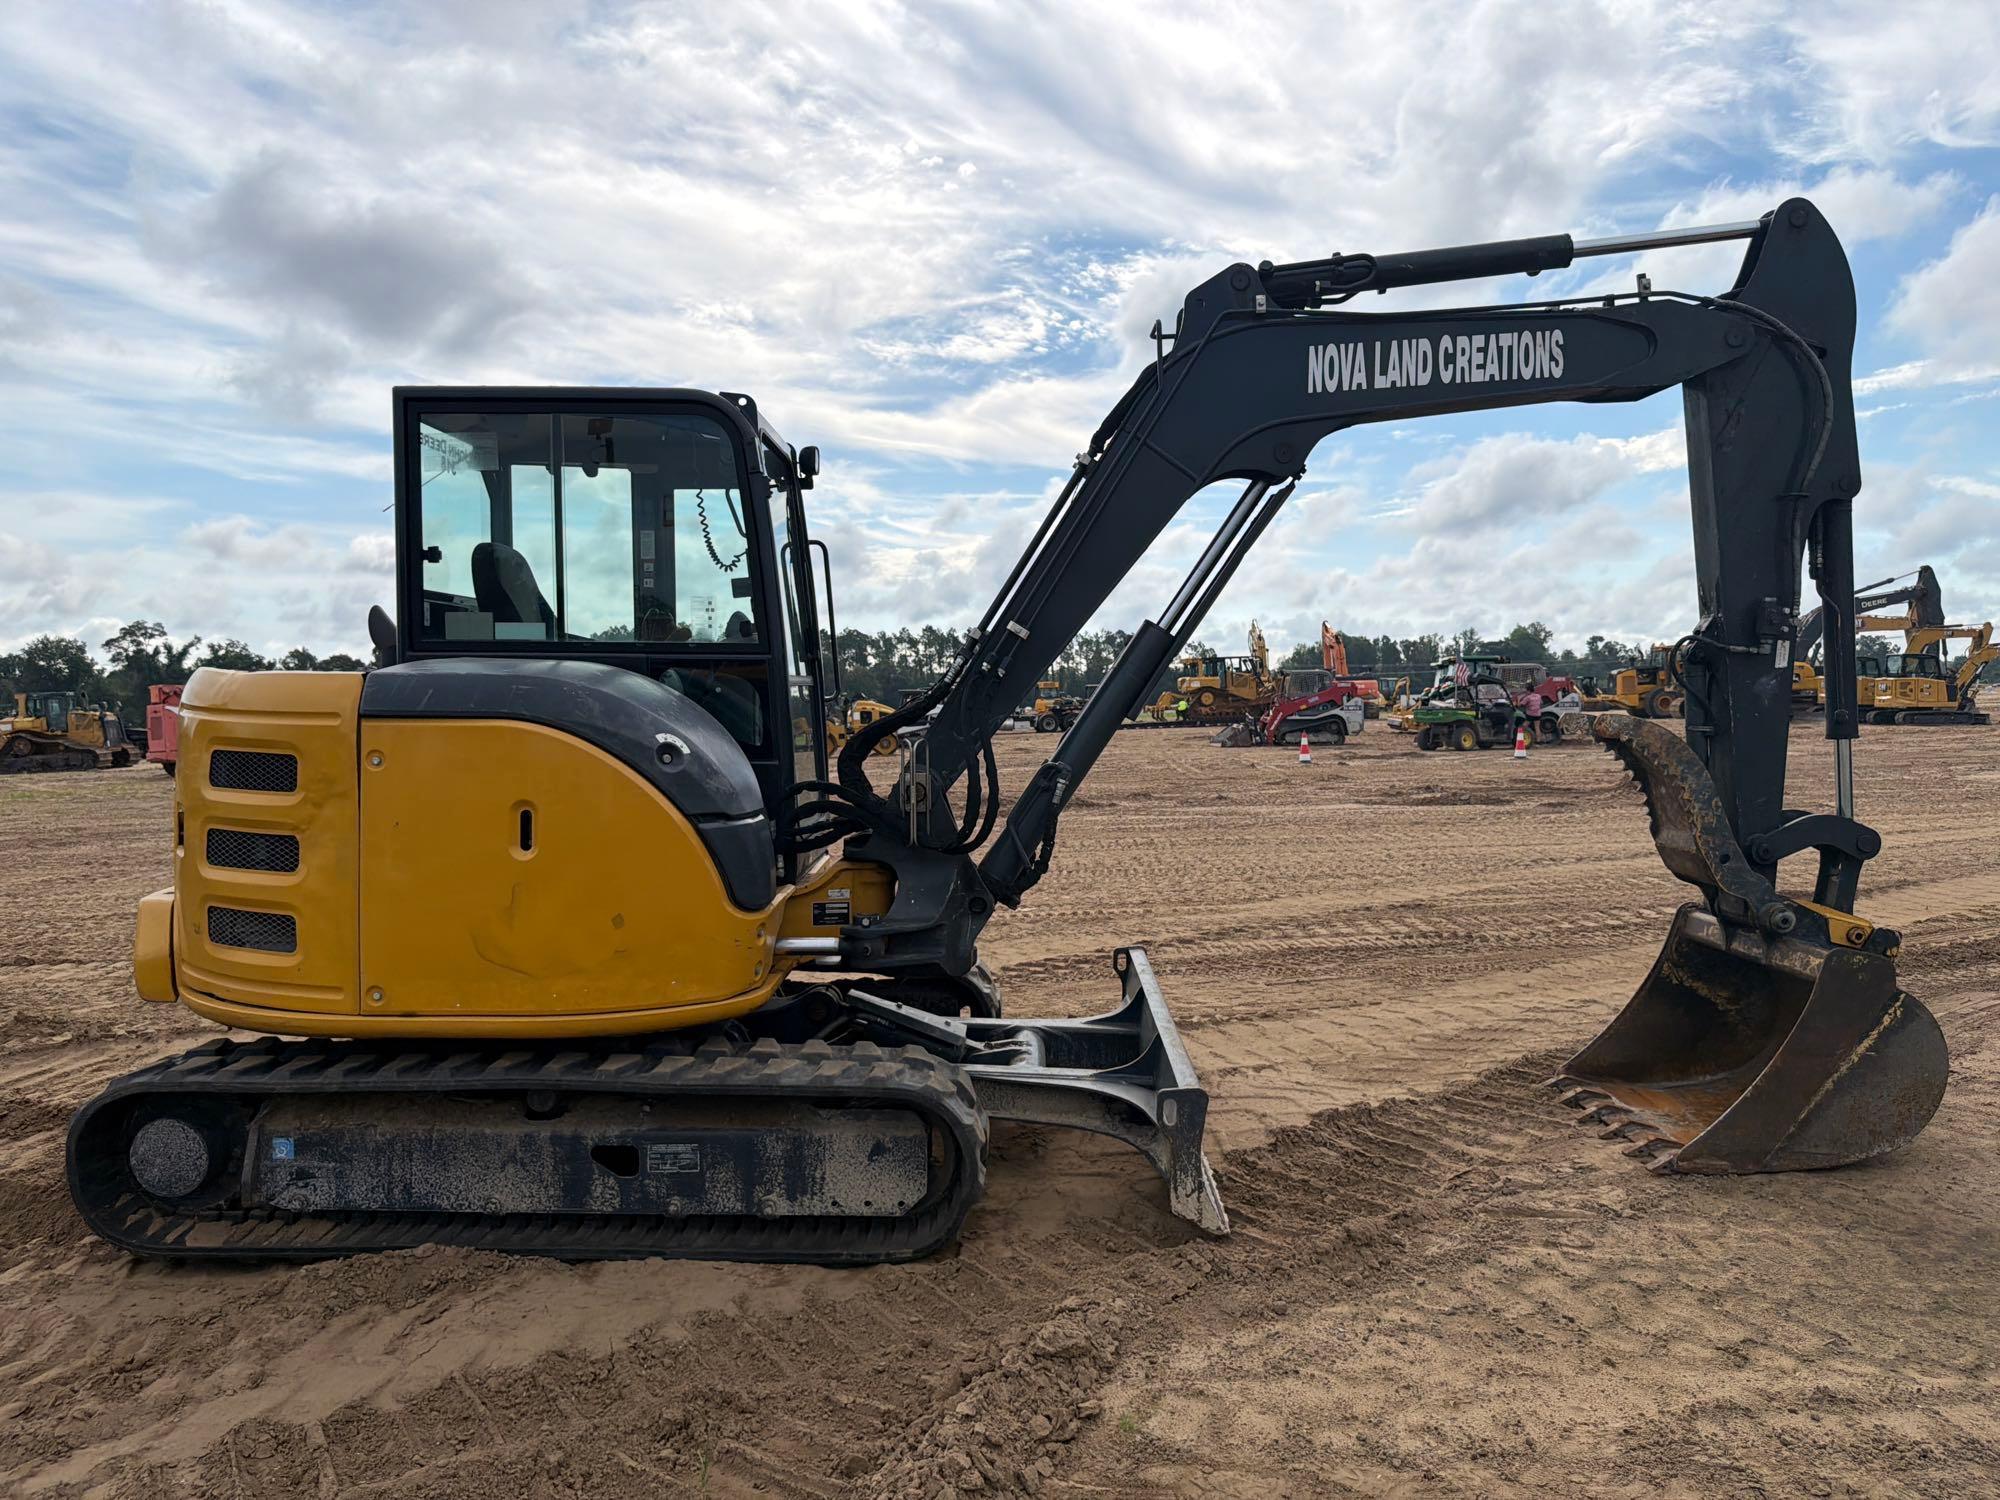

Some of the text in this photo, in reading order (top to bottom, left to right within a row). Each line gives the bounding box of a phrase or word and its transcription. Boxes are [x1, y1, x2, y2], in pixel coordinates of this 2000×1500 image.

[1307, 328, 1565, 394] NOVA LAND CREATIONS
[1861, 598, 1888, 609] DEERE
